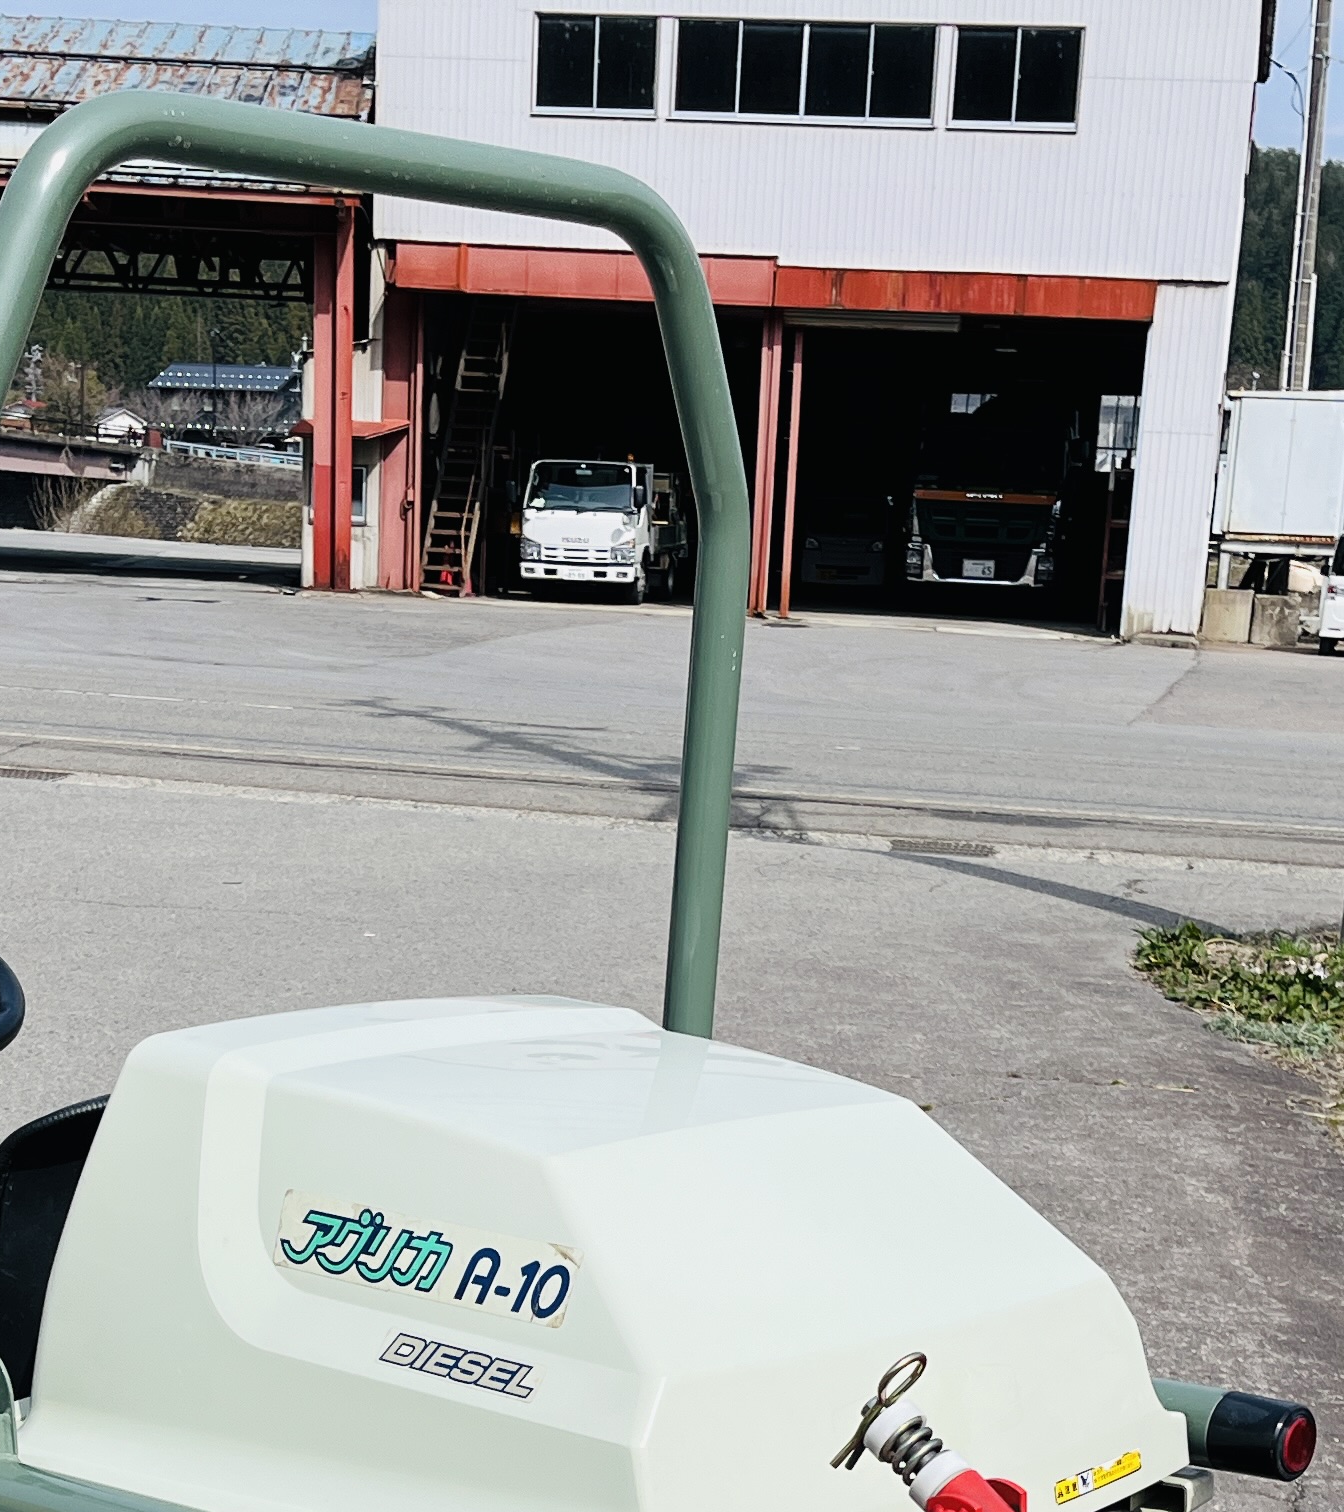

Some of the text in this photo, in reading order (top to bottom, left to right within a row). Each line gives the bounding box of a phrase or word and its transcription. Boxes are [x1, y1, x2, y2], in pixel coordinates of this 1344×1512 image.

[280, 1209, 571, 1319] アグリカ A-10
[379, 1332, 534, 1399] DIESEL
